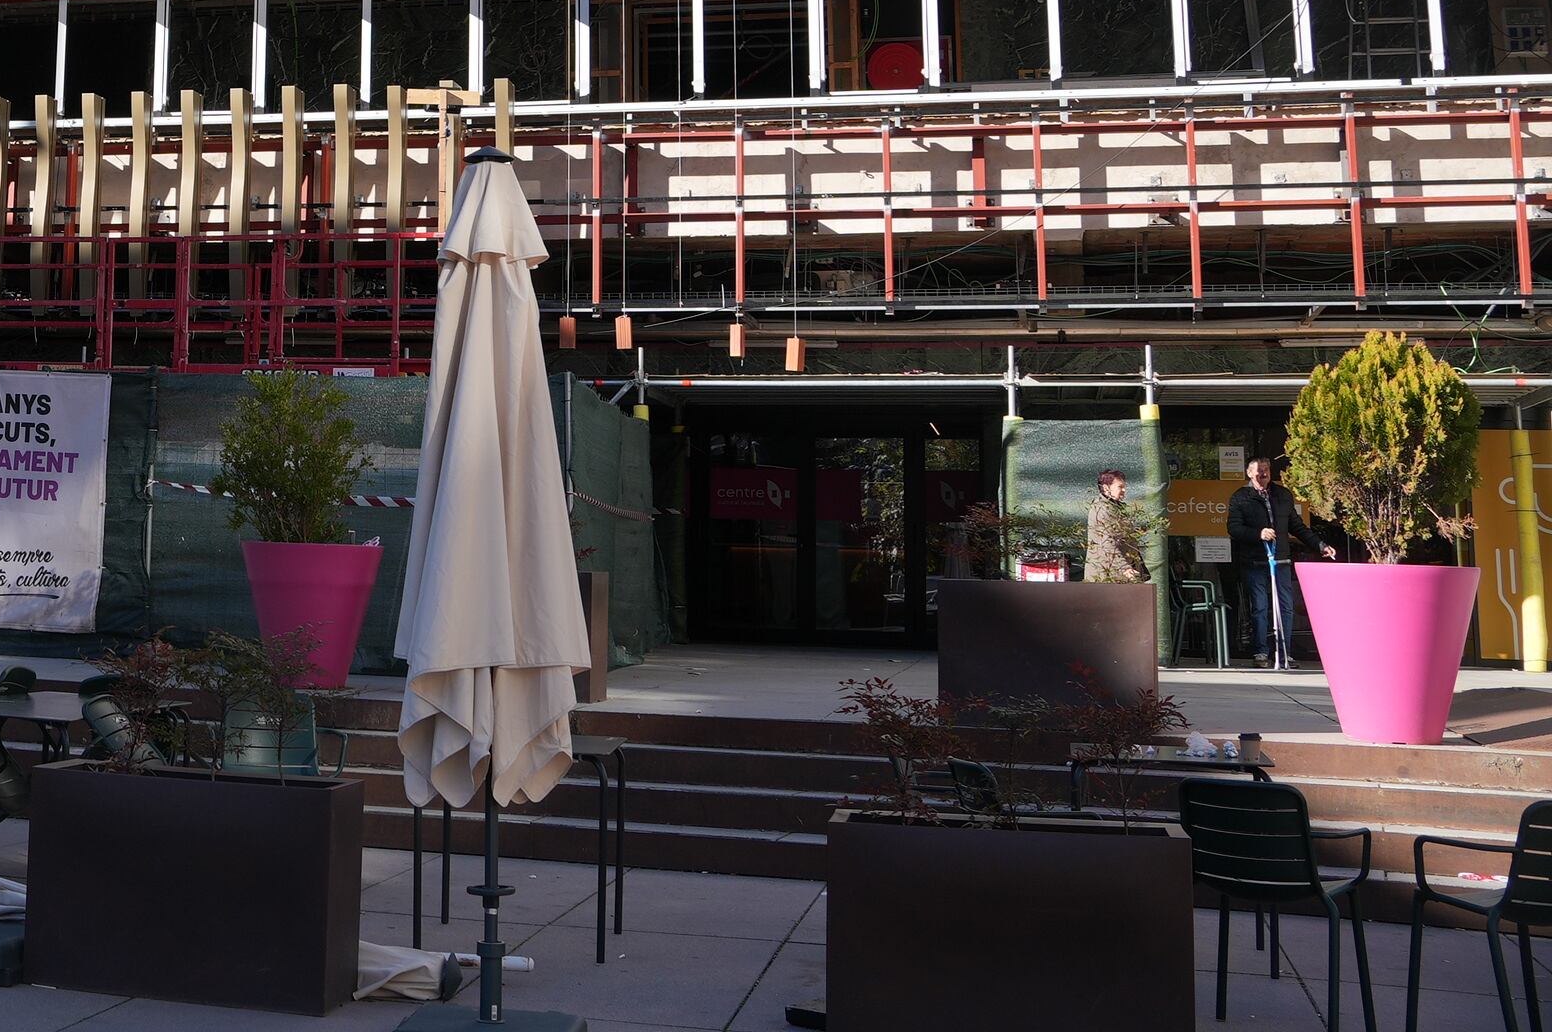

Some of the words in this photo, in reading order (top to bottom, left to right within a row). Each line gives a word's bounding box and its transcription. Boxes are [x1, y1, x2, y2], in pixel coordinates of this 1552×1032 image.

[716, 487, 765, 499] centre
[1167, 497, 1228, 514] cafete
[16, 566, 71, 588] cultura
